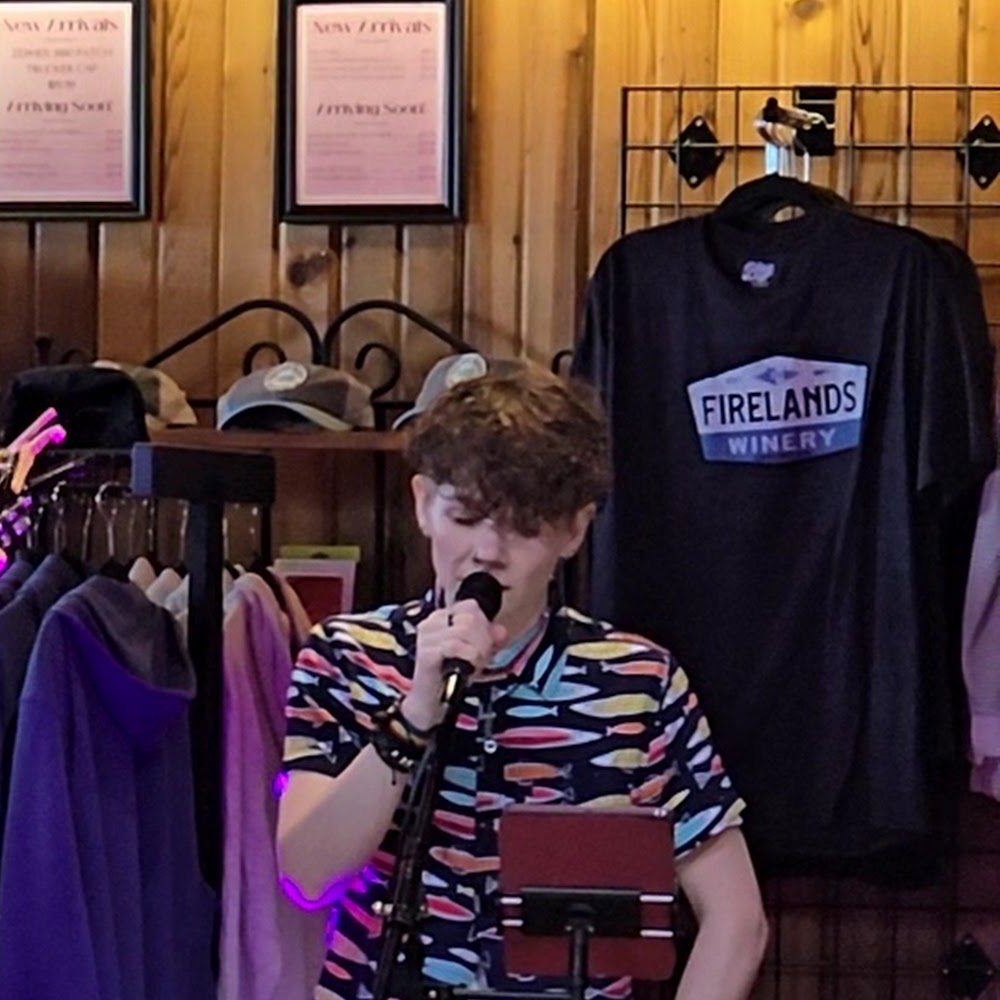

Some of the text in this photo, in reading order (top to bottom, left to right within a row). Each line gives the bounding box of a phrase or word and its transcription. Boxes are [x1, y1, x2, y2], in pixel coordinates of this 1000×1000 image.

[2, 18, 41, 32] New
[313, 20, 351, 34] New
[702, 381, 857, 426] FIRELANDS
[727, 428, 836, 456] WINERY
